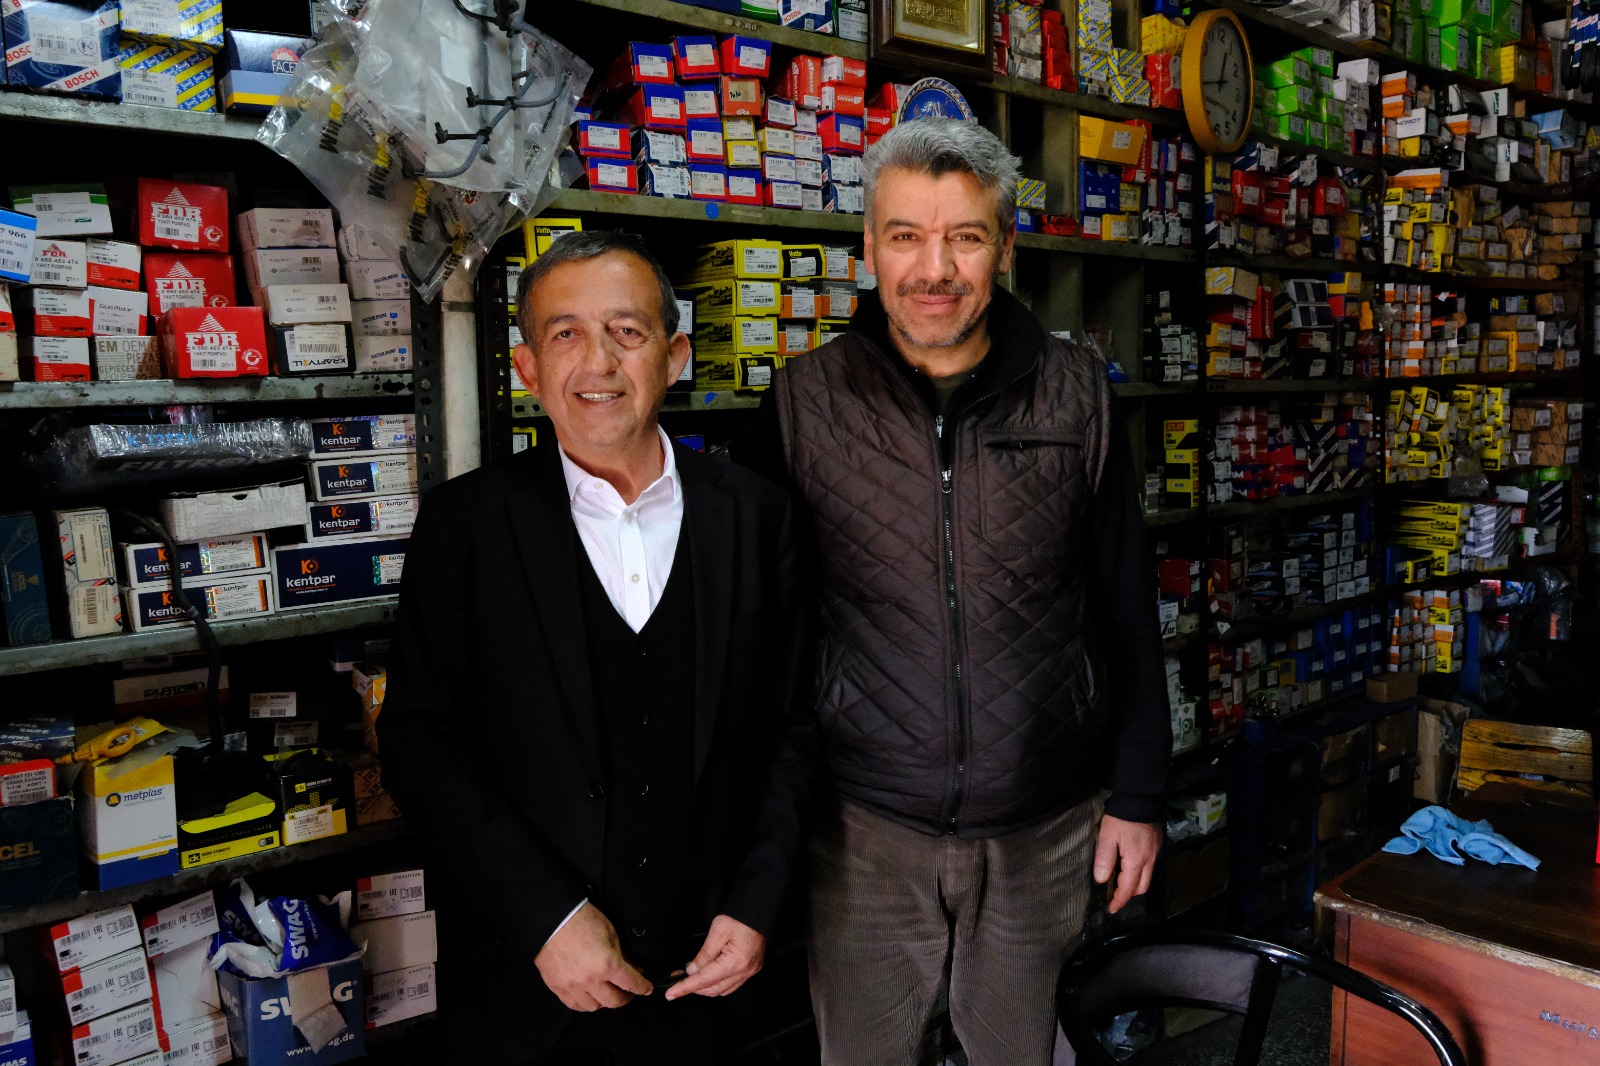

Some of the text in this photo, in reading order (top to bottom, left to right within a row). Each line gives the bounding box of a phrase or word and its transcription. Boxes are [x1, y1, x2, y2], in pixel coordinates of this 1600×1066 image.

[1233, 62, 1239, 78] 2
[64, 68, 100, 90] BOSCH
[1224, 120, 1231, 136] 5
[151, 203, 202, 222] FDR
[9, 229, 27, 239] 966
[42, 249, 68, 258] FDR
[155, 278, 207, 293] FDR
[185, 333, 240, 347] FDR
[320, 435, 361, 446] kentpar
[327, 478, 367, 489] kentpar
[319, 517, 361, 529] kentpar
[217, 538, 243, 546] kentpar
[144, 560, 192, 574] kentar
[223, 583, 249, 592] kentpar
[286, 574, 336, 588] kentpar
[123, 787, 163, 802] metplas
[282, 898, 309, 960] SWAG
[116, 1007, 151, 1023] SCHAEFFLER
